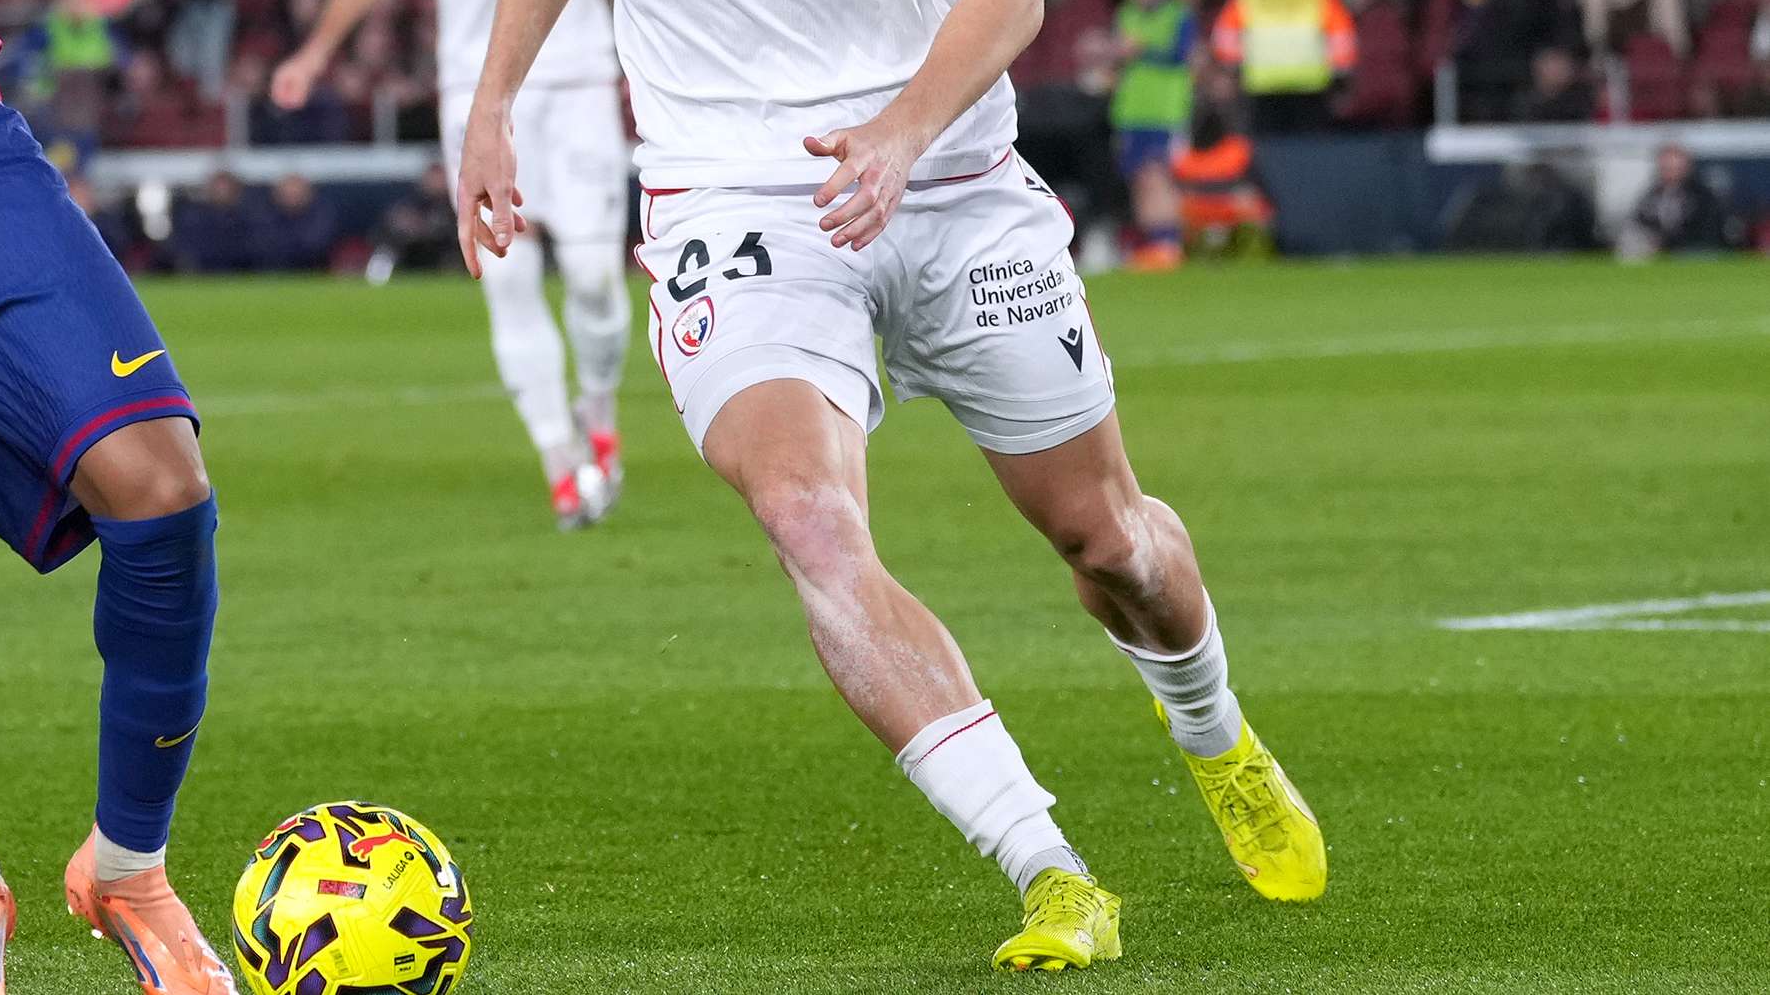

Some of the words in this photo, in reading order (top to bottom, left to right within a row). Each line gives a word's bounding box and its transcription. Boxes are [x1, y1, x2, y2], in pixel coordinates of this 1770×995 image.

[969, 259, 1034, 285] Clínica
[976, 310, 1000, 328] de
[1006, 292, 1072, 325] Navarra
